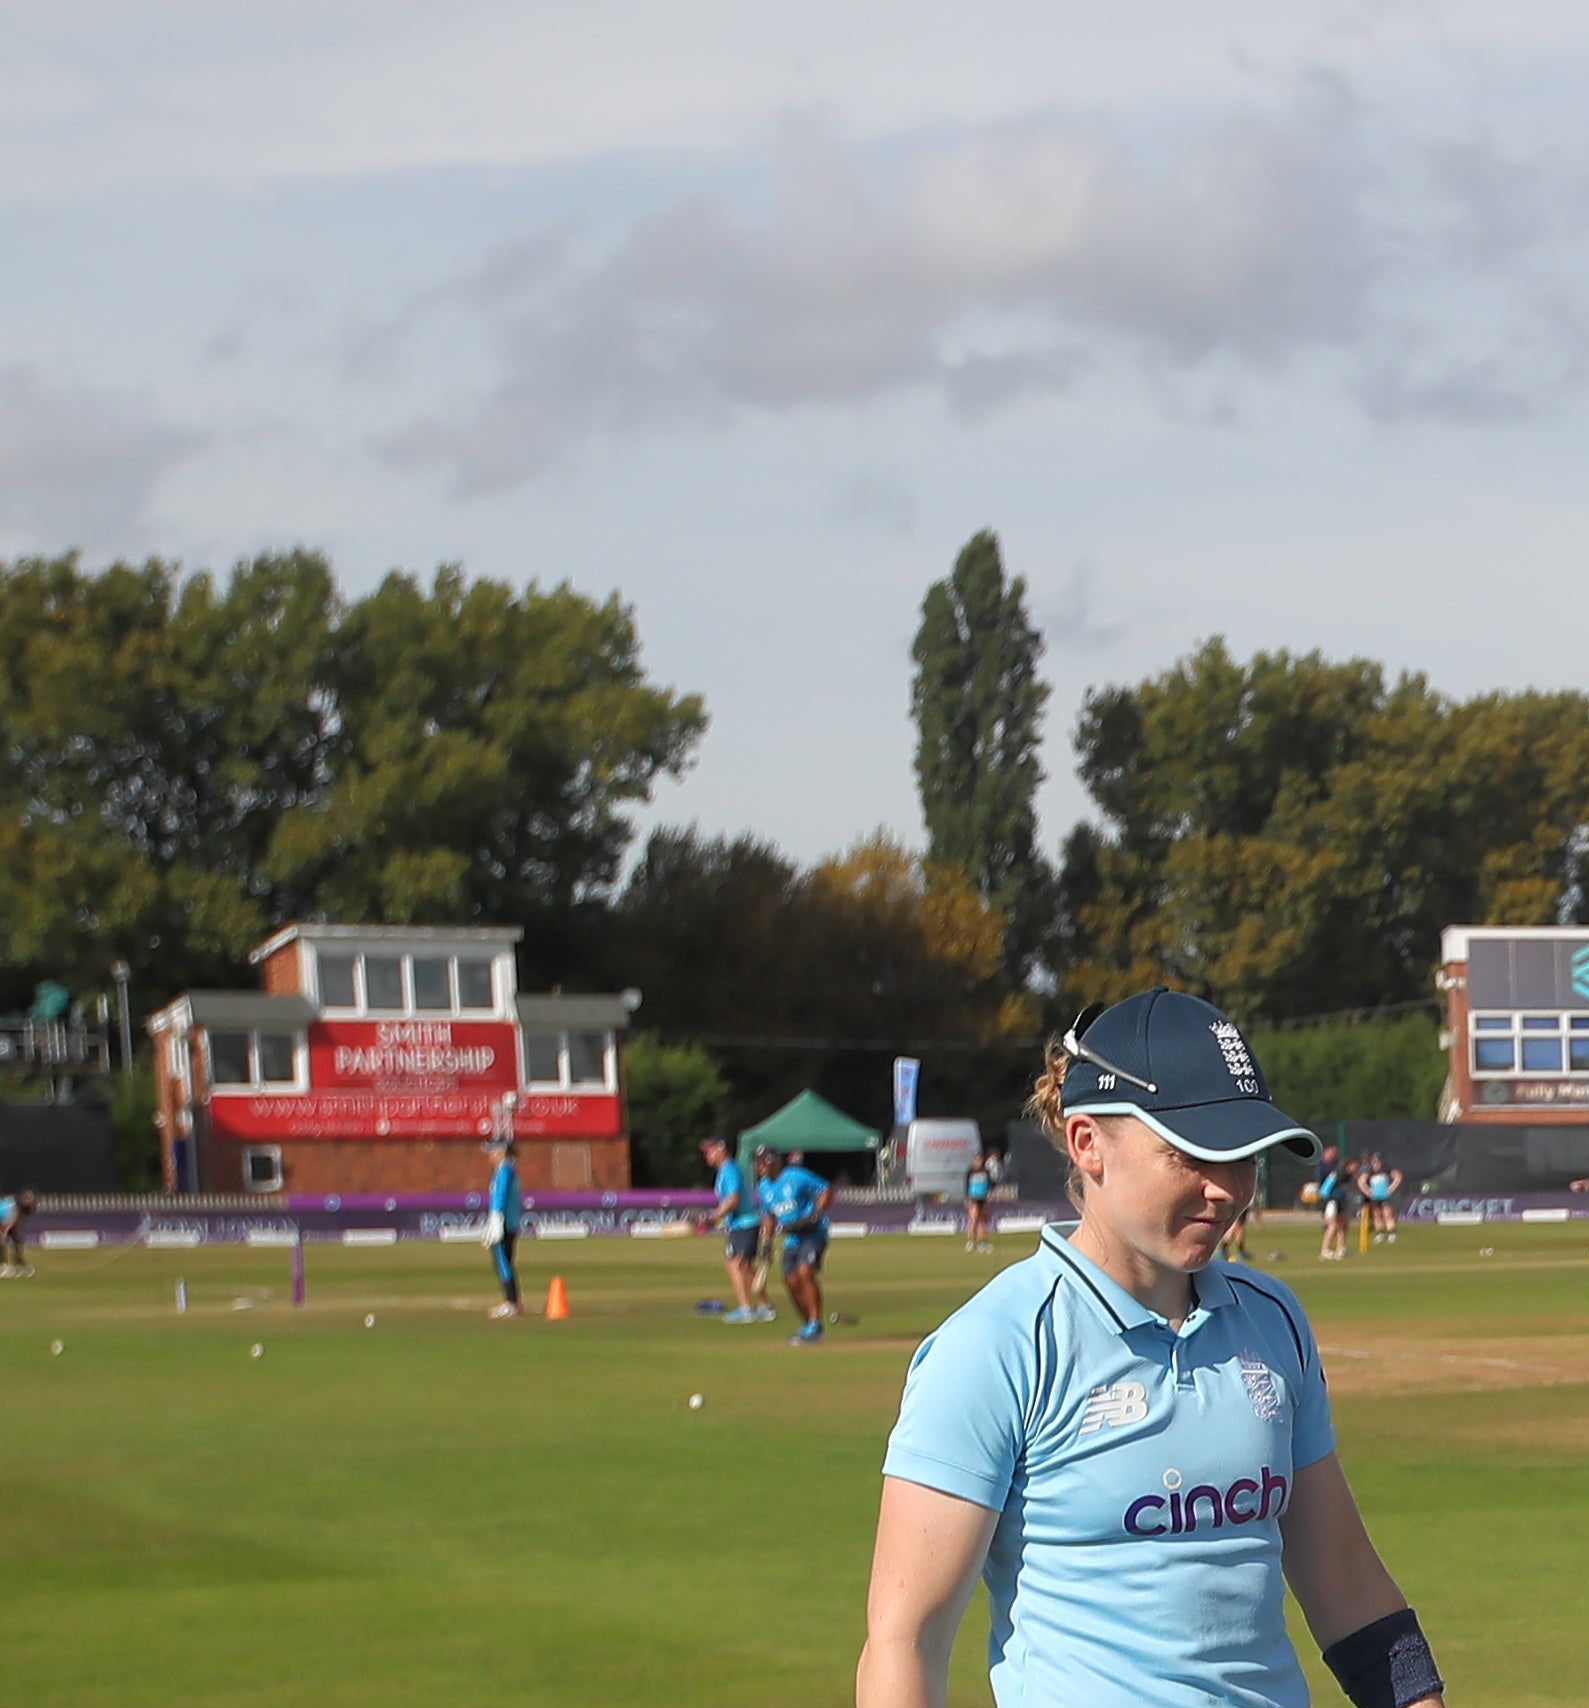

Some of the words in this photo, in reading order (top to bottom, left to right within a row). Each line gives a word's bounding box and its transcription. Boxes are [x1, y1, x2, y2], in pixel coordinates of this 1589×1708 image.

[377, 1023, 451, 1046] SMITH
[335, 1046, 496, 1075] PARTNERSHIP
[1124, 1466, 1288, 1537] cinch
